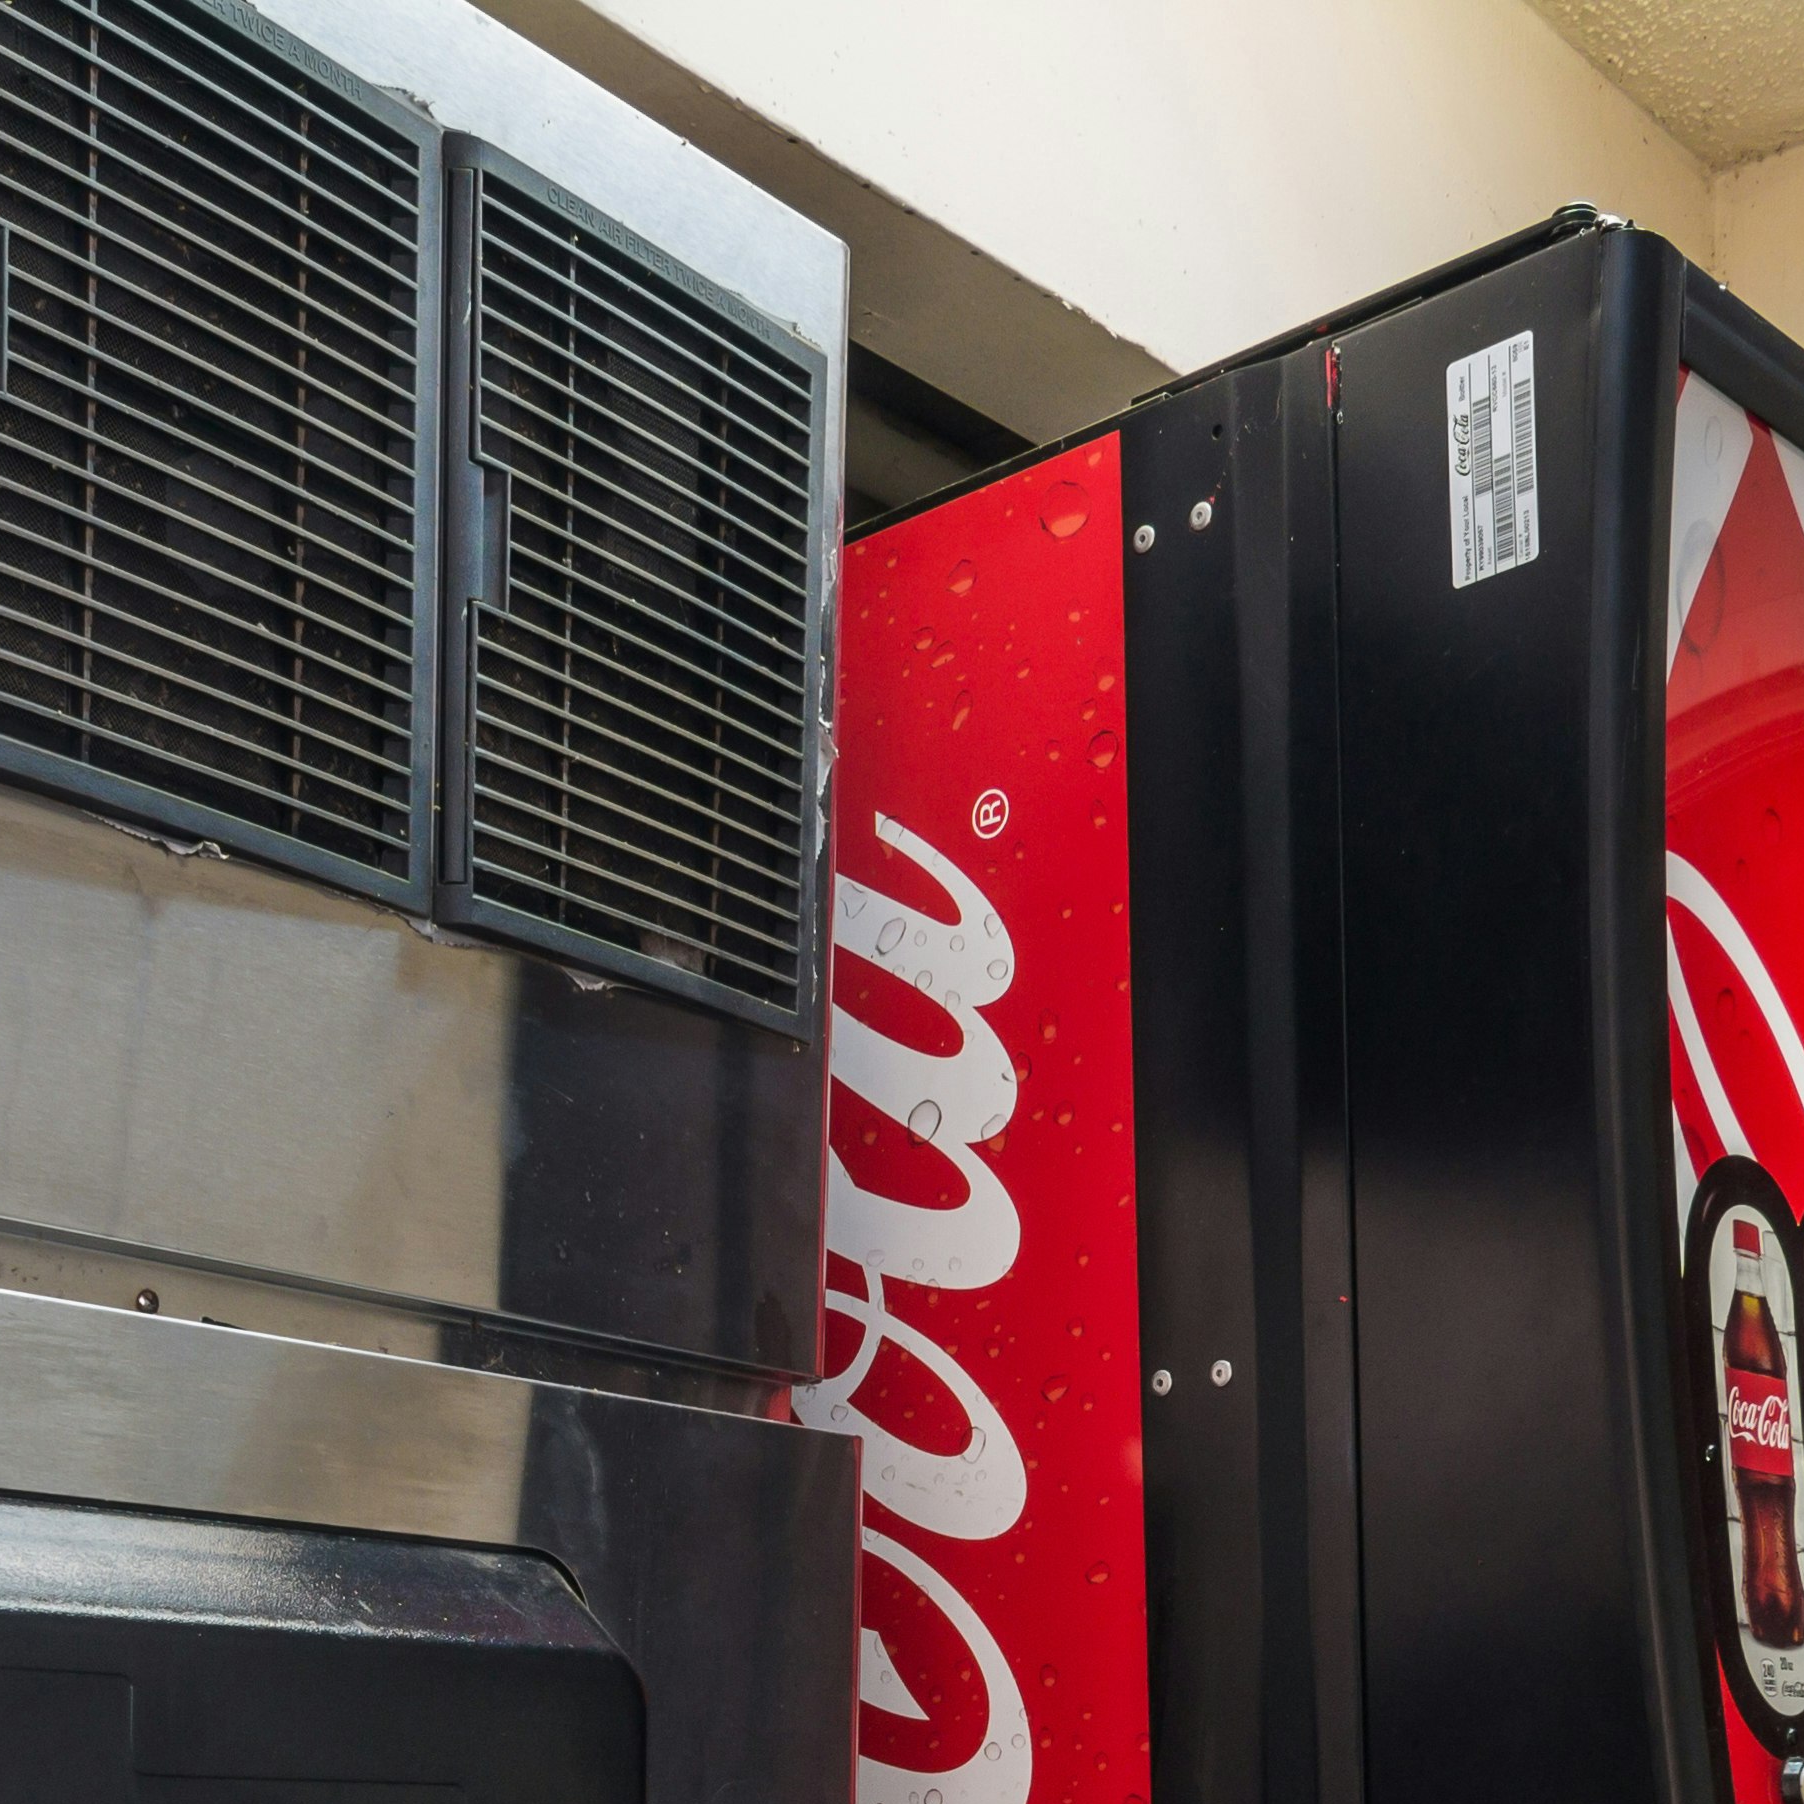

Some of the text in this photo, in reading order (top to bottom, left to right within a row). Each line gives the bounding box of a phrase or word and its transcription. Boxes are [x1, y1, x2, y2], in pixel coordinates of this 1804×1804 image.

[1455, 414, 1471, 477] Coca-Cola
[1463, 537, 1469, 546] of
[1728, 1386, 1790, 1450] Coca-Cola
